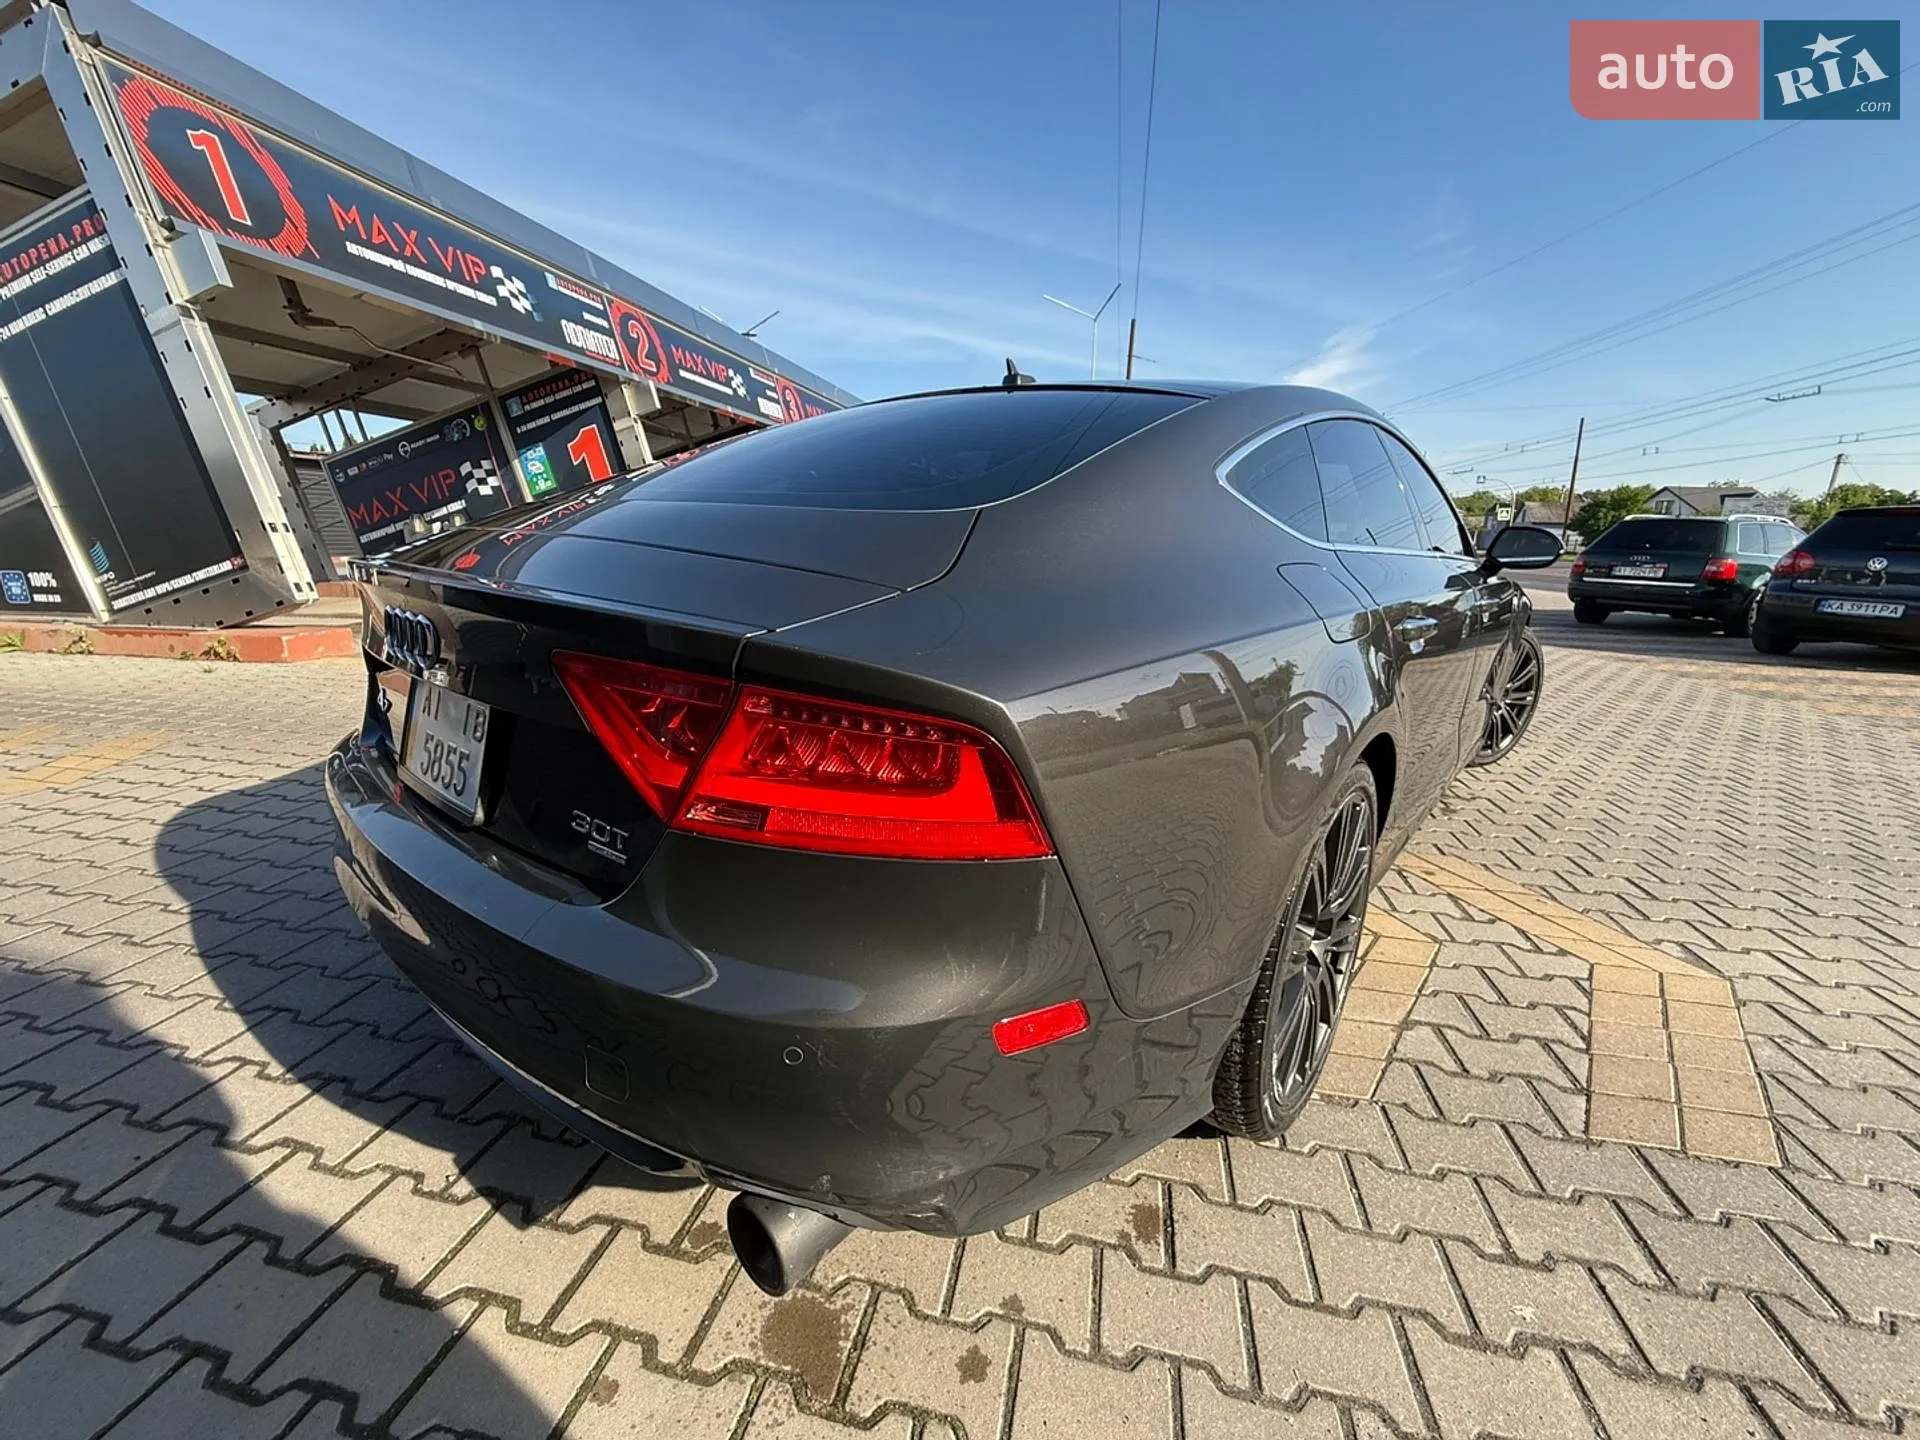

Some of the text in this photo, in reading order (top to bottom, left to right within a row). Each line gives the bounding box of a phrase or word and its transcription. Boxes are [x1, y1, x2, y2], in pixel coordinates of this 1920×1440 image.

[186, 128, 253, 227] 1
[0, 213, 104, 285] UTOPENA.PRO
[326, 193, 427, 264] MAX
[427, 235, 488, 285] VIP
[627, 319, 657, 372] 2
[670, 343, 707, 376] MAX
[704, 357, 727, 384] VIP
[567, 423, 614, 484] 1
[347, 486, 409, 530] MAX
[407, 467, 457, 504] VIP
[27, 571, 57, 587] 100%
[420, 729, 471, 798] 5855
